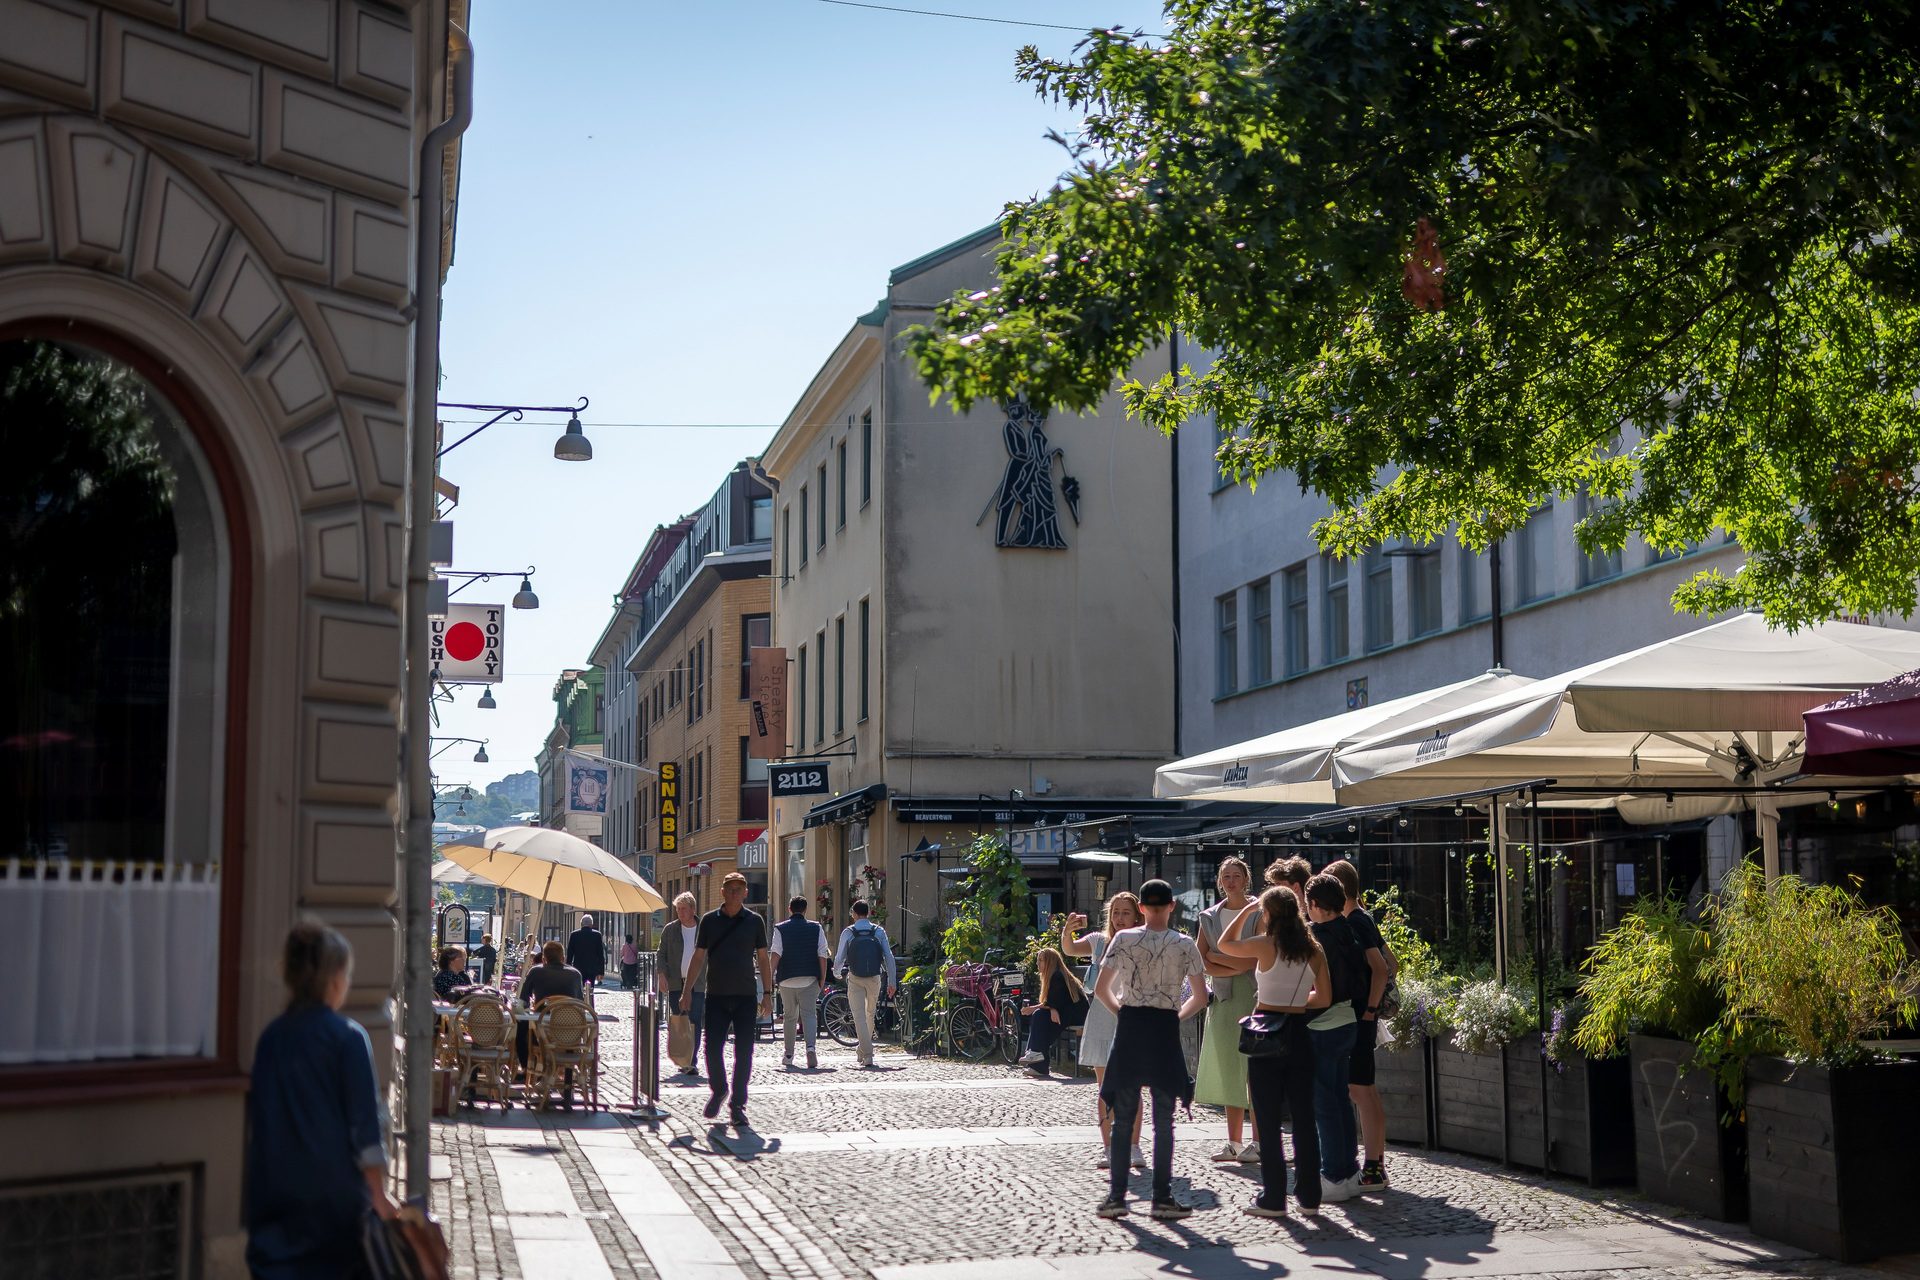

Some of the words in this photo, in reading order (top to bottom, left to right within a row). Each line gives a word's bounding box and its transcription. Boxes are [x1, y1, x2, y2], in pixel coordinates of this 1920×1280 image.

[430, 621, 445, 670] USHI
[485, 609, 500, 676] TODAY
[768, 665, 784, 730] Sneaky
[1416, 730, 1452, 756] LAVAZZA
[778, 771, 822, 789] 2112
[1223, 761, 1249, 783] LAVAZZA
[661, 764, 675, 850] SNABB
[915, 813, 952, 821] BEAVERTOWN
[743, 843, 766, 868] fjäll
